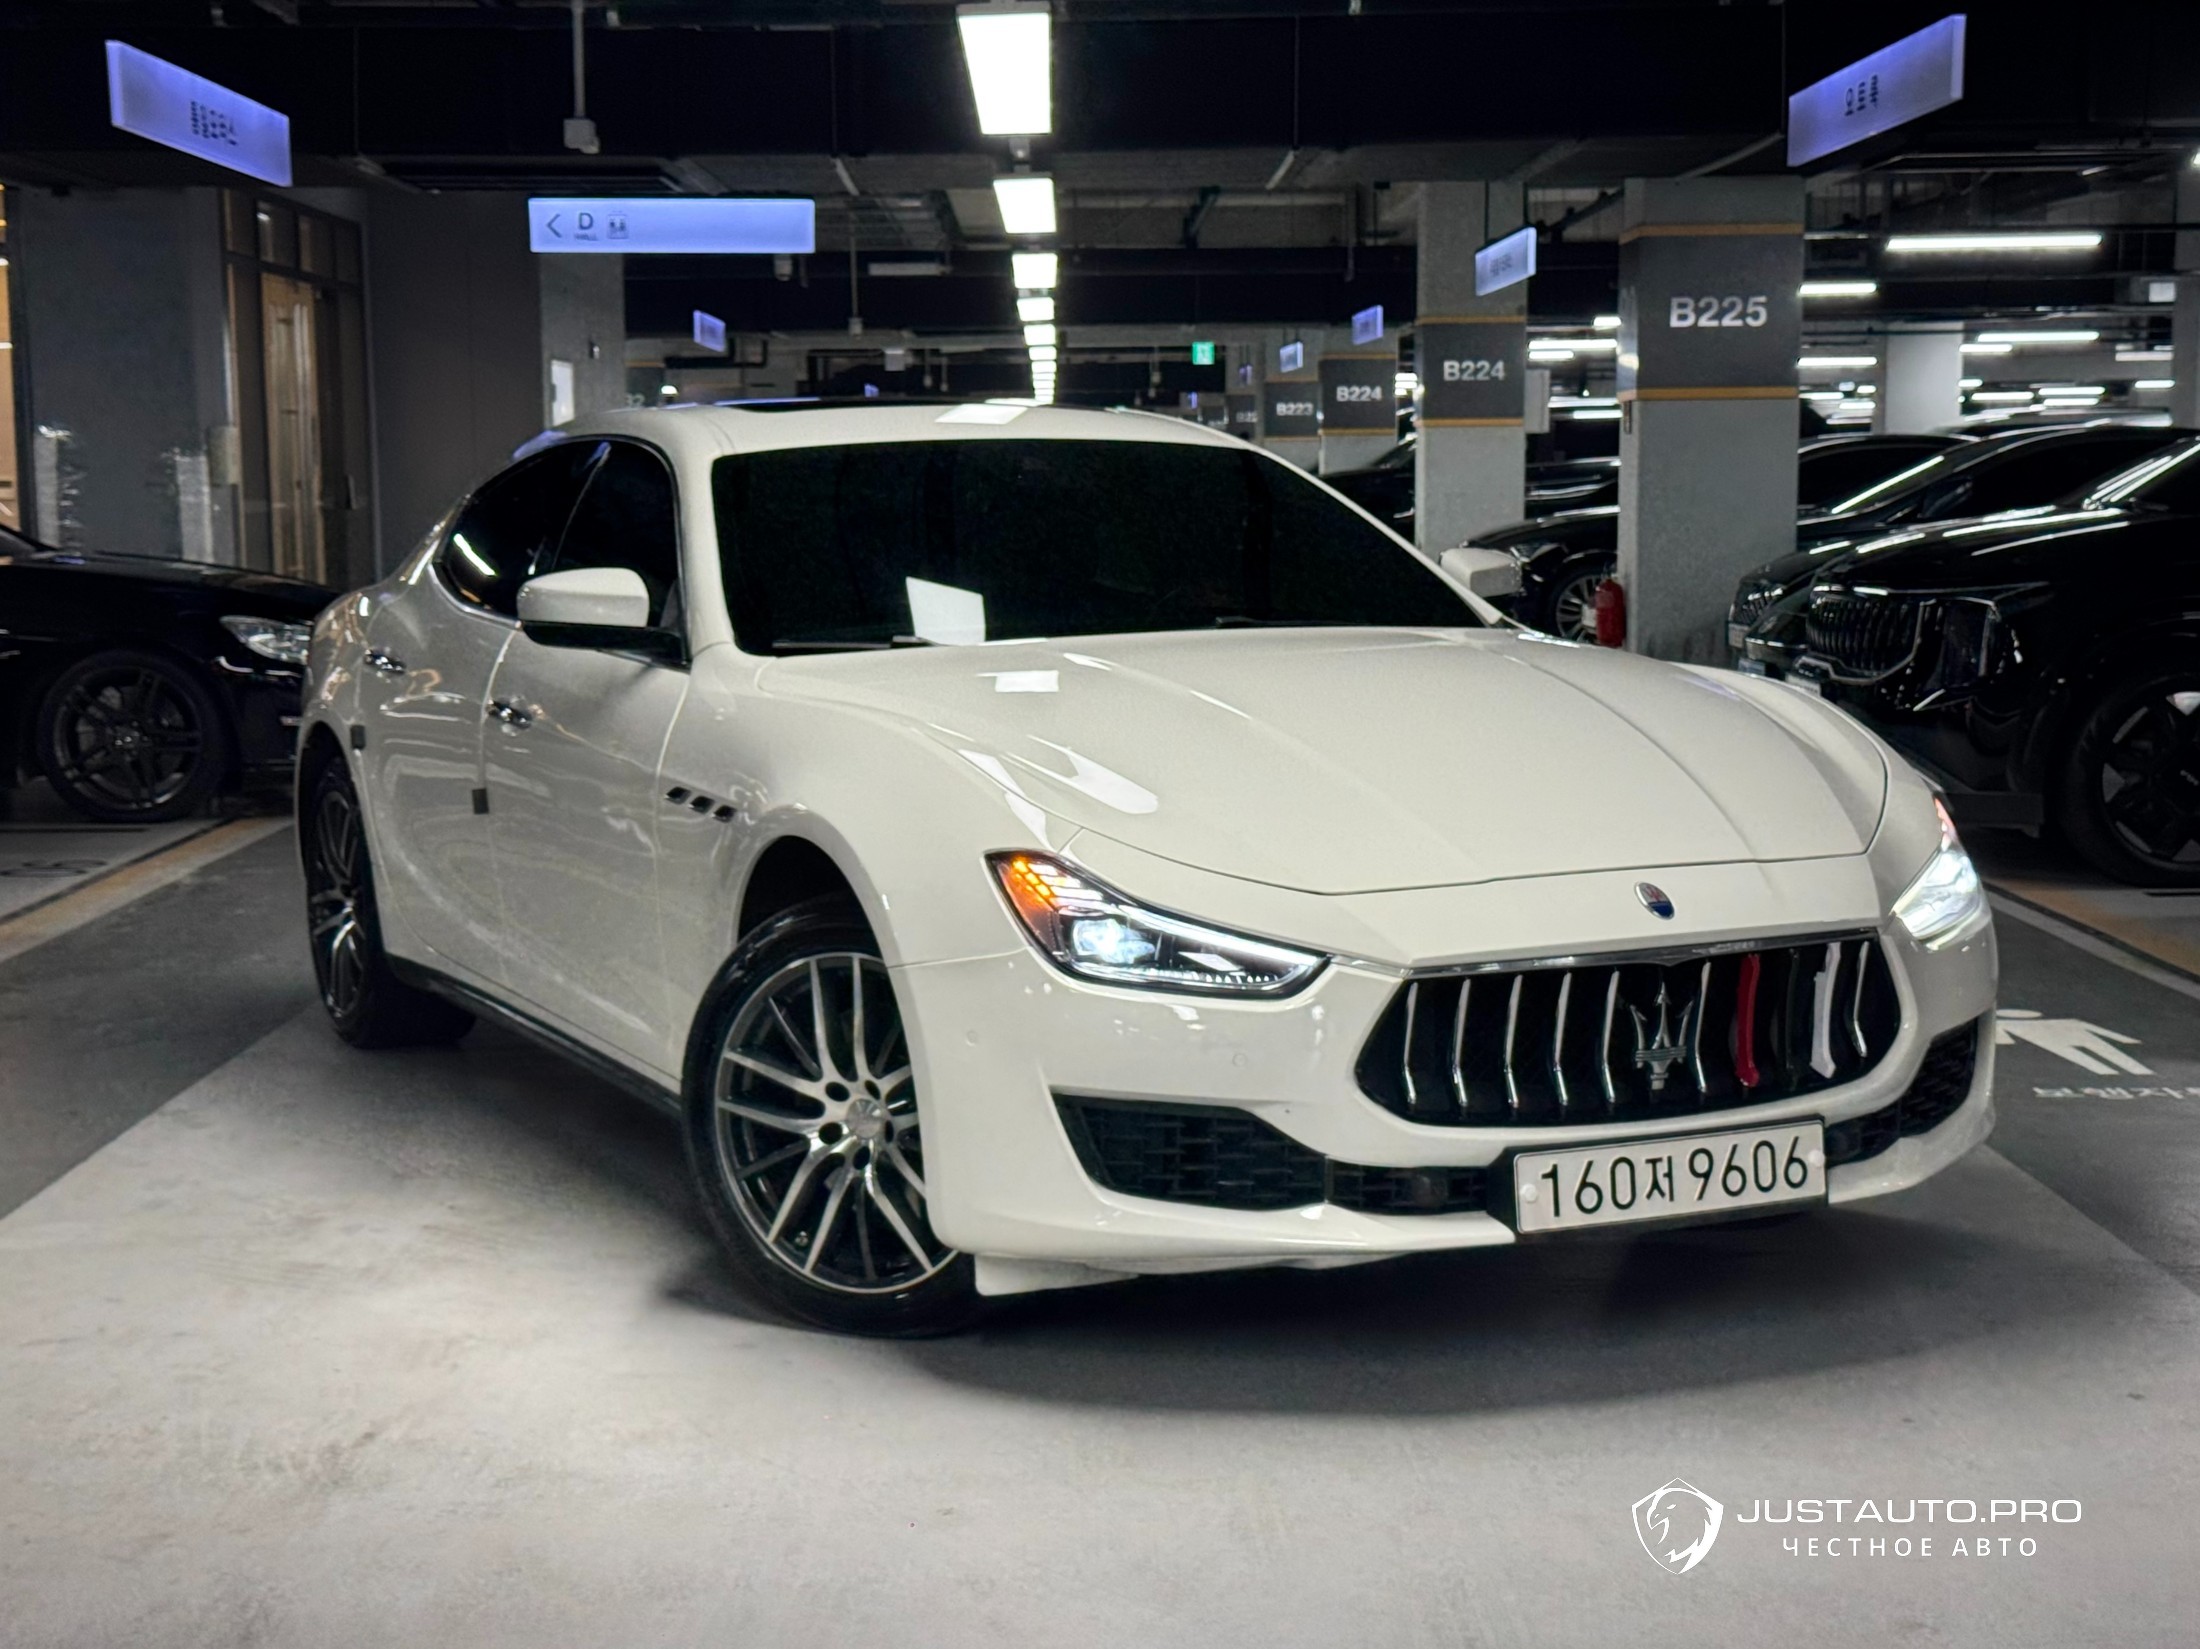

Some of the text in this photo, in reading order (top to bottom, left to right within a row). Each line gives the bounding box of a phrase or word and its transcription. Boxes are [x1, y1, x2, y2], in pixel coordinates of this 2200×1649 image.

[578, 212, 594, 230] D
[1669, 295, 1768, 328] B225
[1443, 360, 1505, 381] B224
[1336, 385, 1382, 402] B224
[1276, 402, 1313, 416] B223
